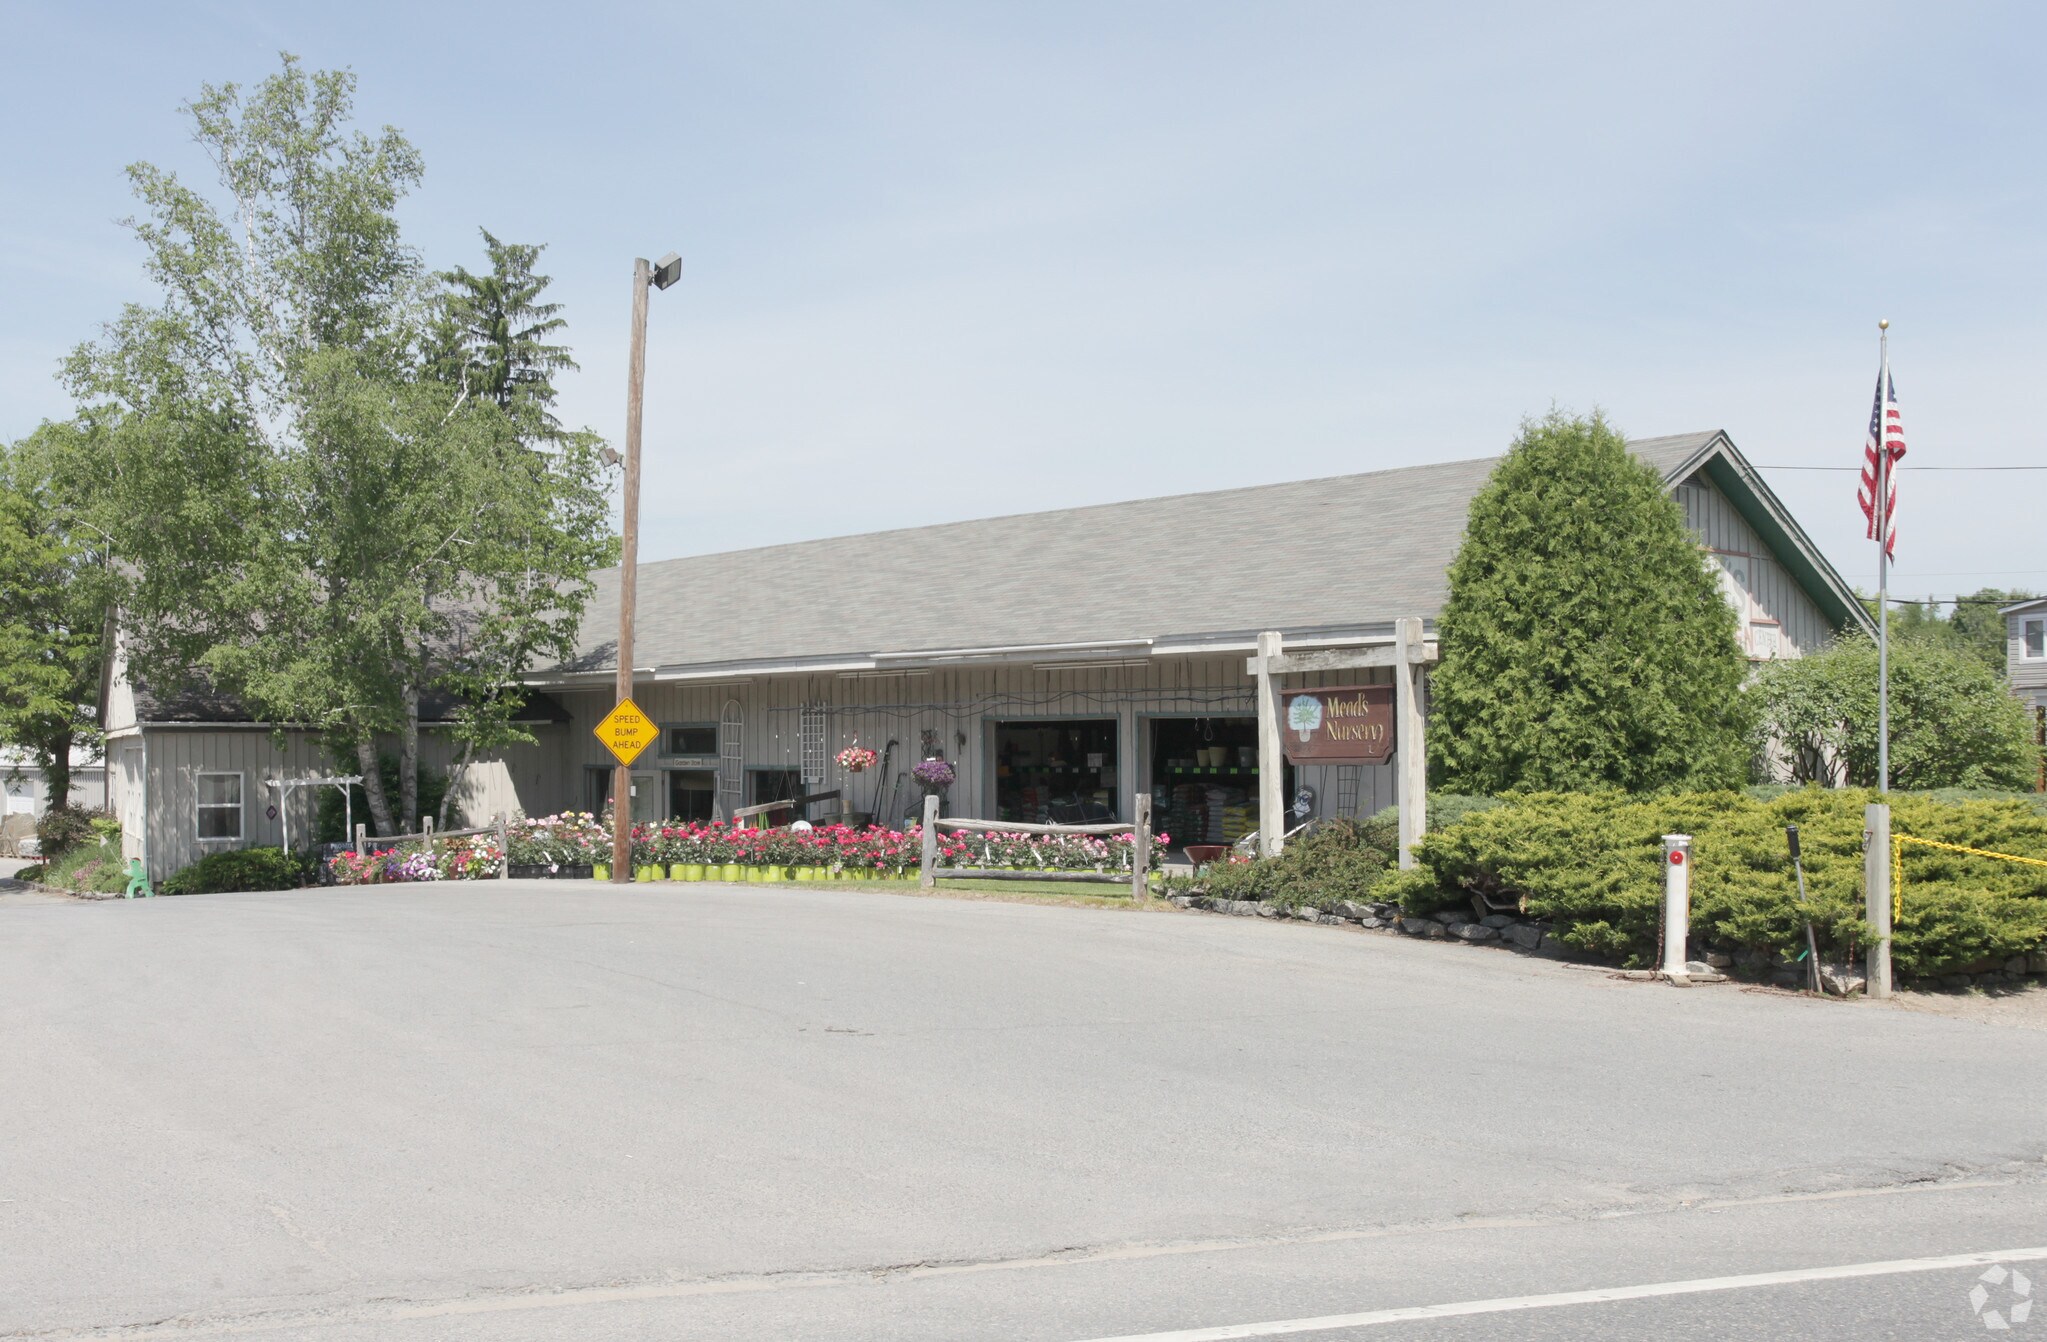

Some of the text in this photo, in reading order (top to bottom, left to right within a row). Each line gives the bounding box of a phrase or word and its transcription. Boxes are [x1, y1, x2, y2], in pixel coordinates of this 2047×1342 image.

[1326, 692, 1369, 718] Mead's
[614, 715, 640, 723] SPEED
[615, 728, 638, 736] BUMP
[1326, 720, 1384, 743] Nursery
[613, 741, 641, 749] AHEAD
